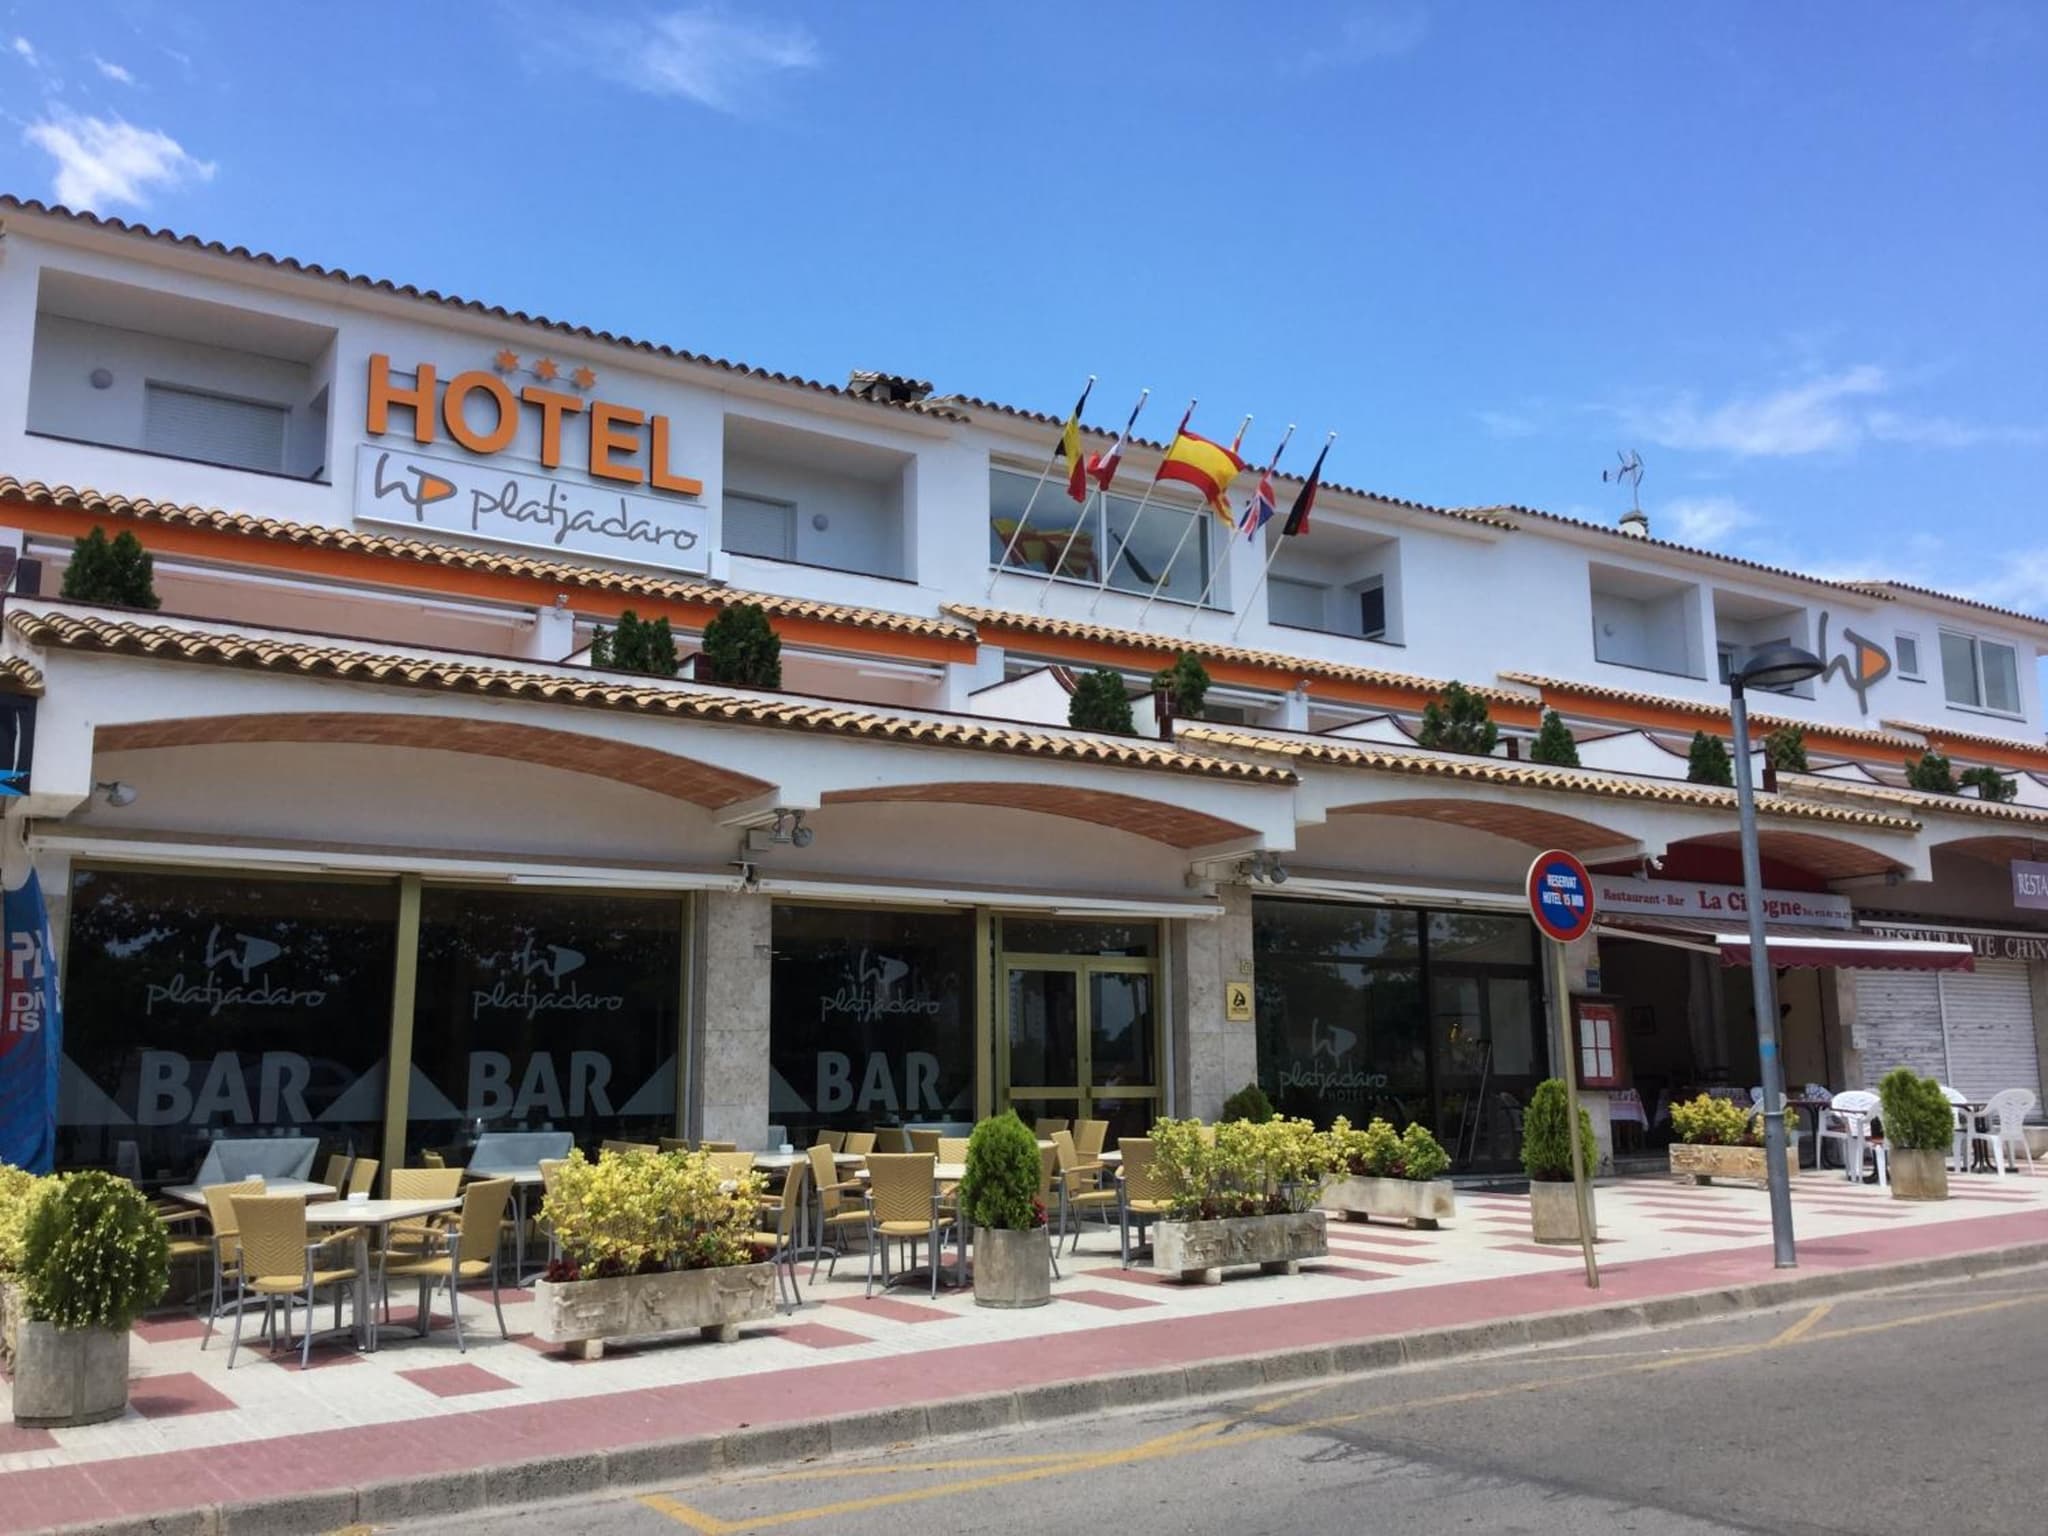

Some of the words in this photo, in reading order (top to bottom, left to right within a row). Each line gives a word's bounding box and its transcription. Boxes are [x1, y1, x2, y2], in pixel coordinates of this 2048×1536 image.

[367, 352, 703, 497] HOTEL
[470, 480, 698, 551] platjadaro
[1603, 889, 1661, 905] Restaurant
[1667, 894, 1686, 906] Bar
[1698, 890, 1722, 910] La
[2004, 937, 2048, 960] CHIN
[146, 971, 327, 1017] platjadaro
[137, 1049, 313, 1126] BAR
[466, 1051, 615, 1120] BAR
[816, 1051, 943, 1113] BAR
